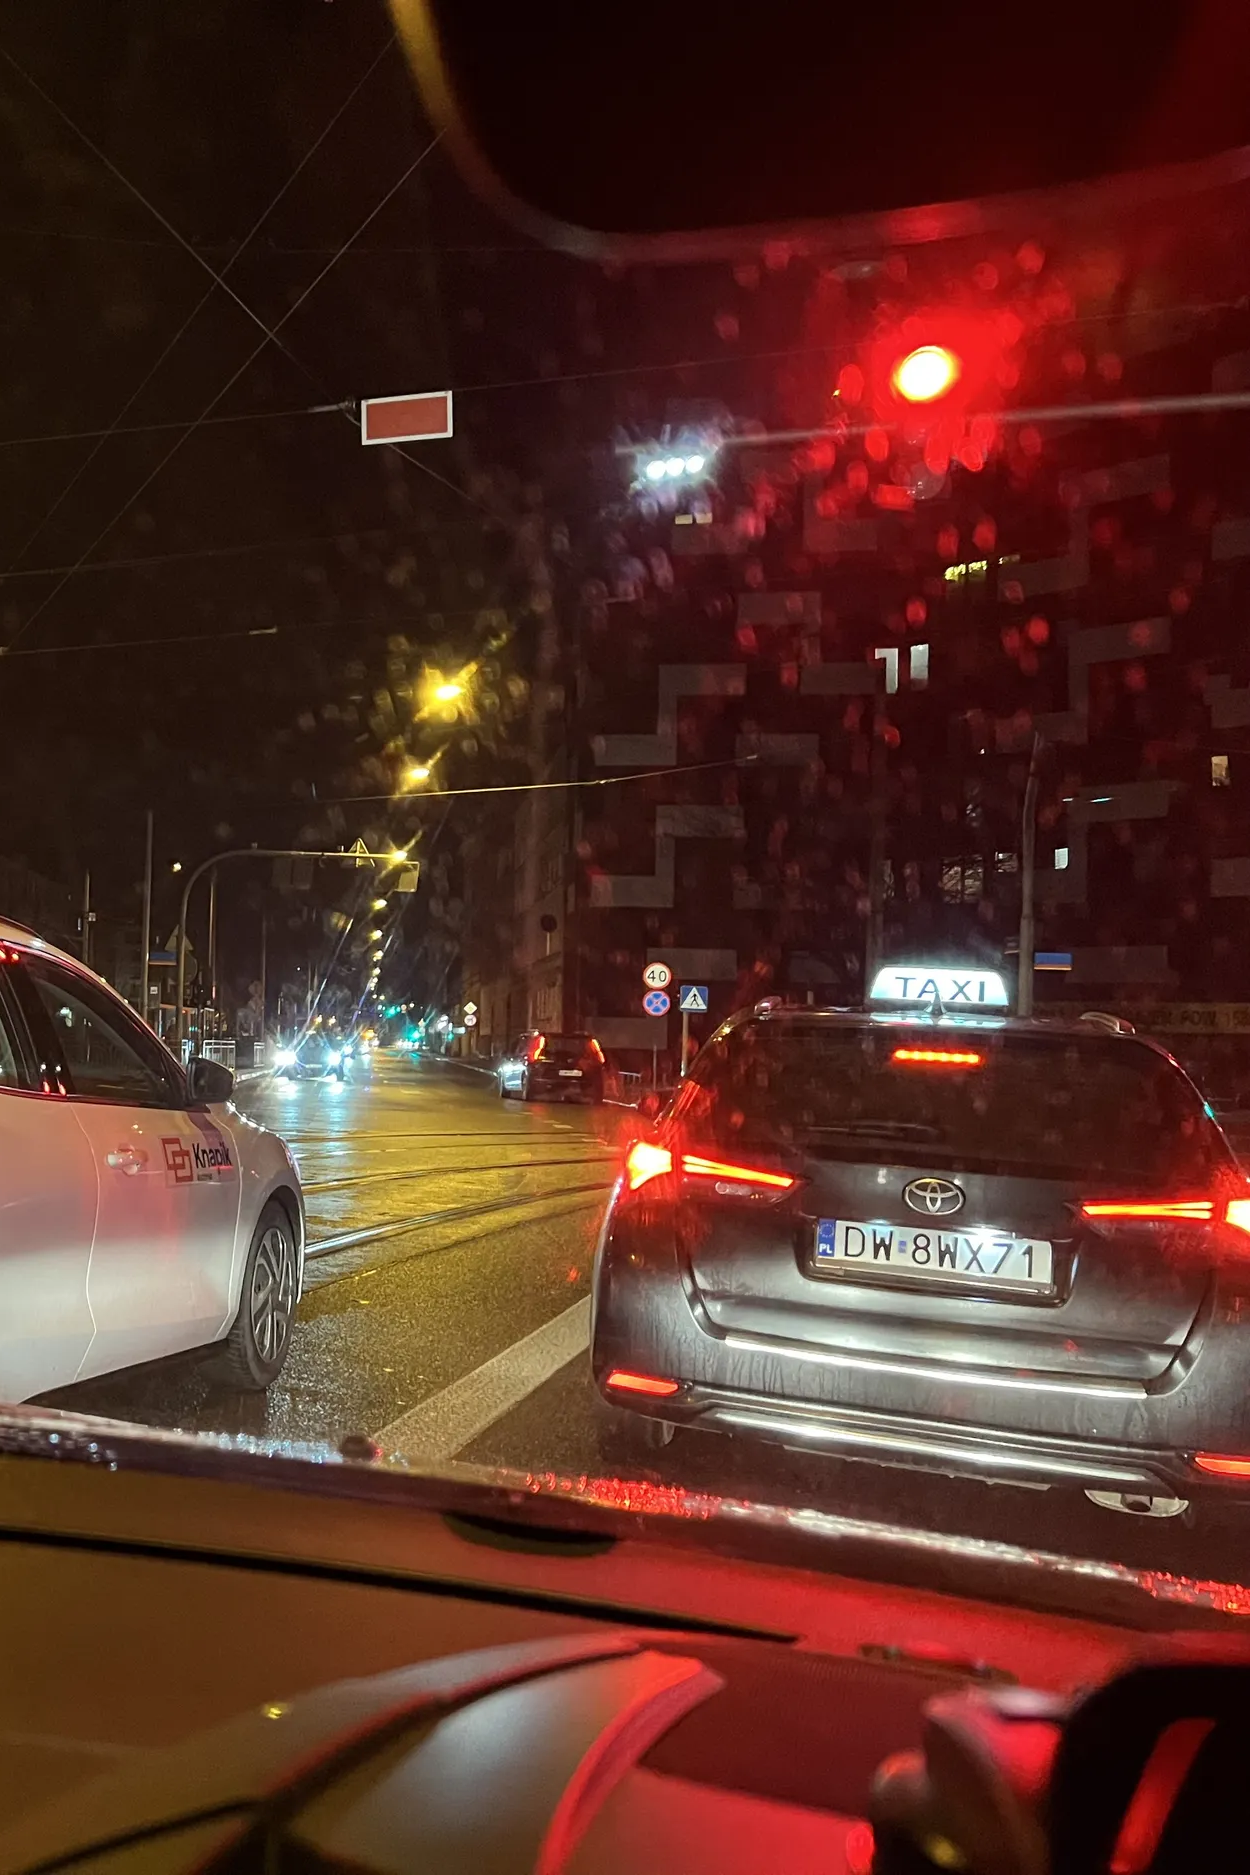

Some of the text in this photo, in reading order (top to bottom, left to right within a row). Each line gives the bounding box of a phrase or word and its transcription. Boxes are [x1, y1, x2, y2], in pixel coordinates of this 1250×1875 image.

[647, 970, 667, 982] 40
[895, 976, 985, 1002] TAXI
[192, 1141, 233, 1175] Knapik
[819, 1243, 833, 1255] PL
[844, 1226, 1033, 1279] DW 8WX71
